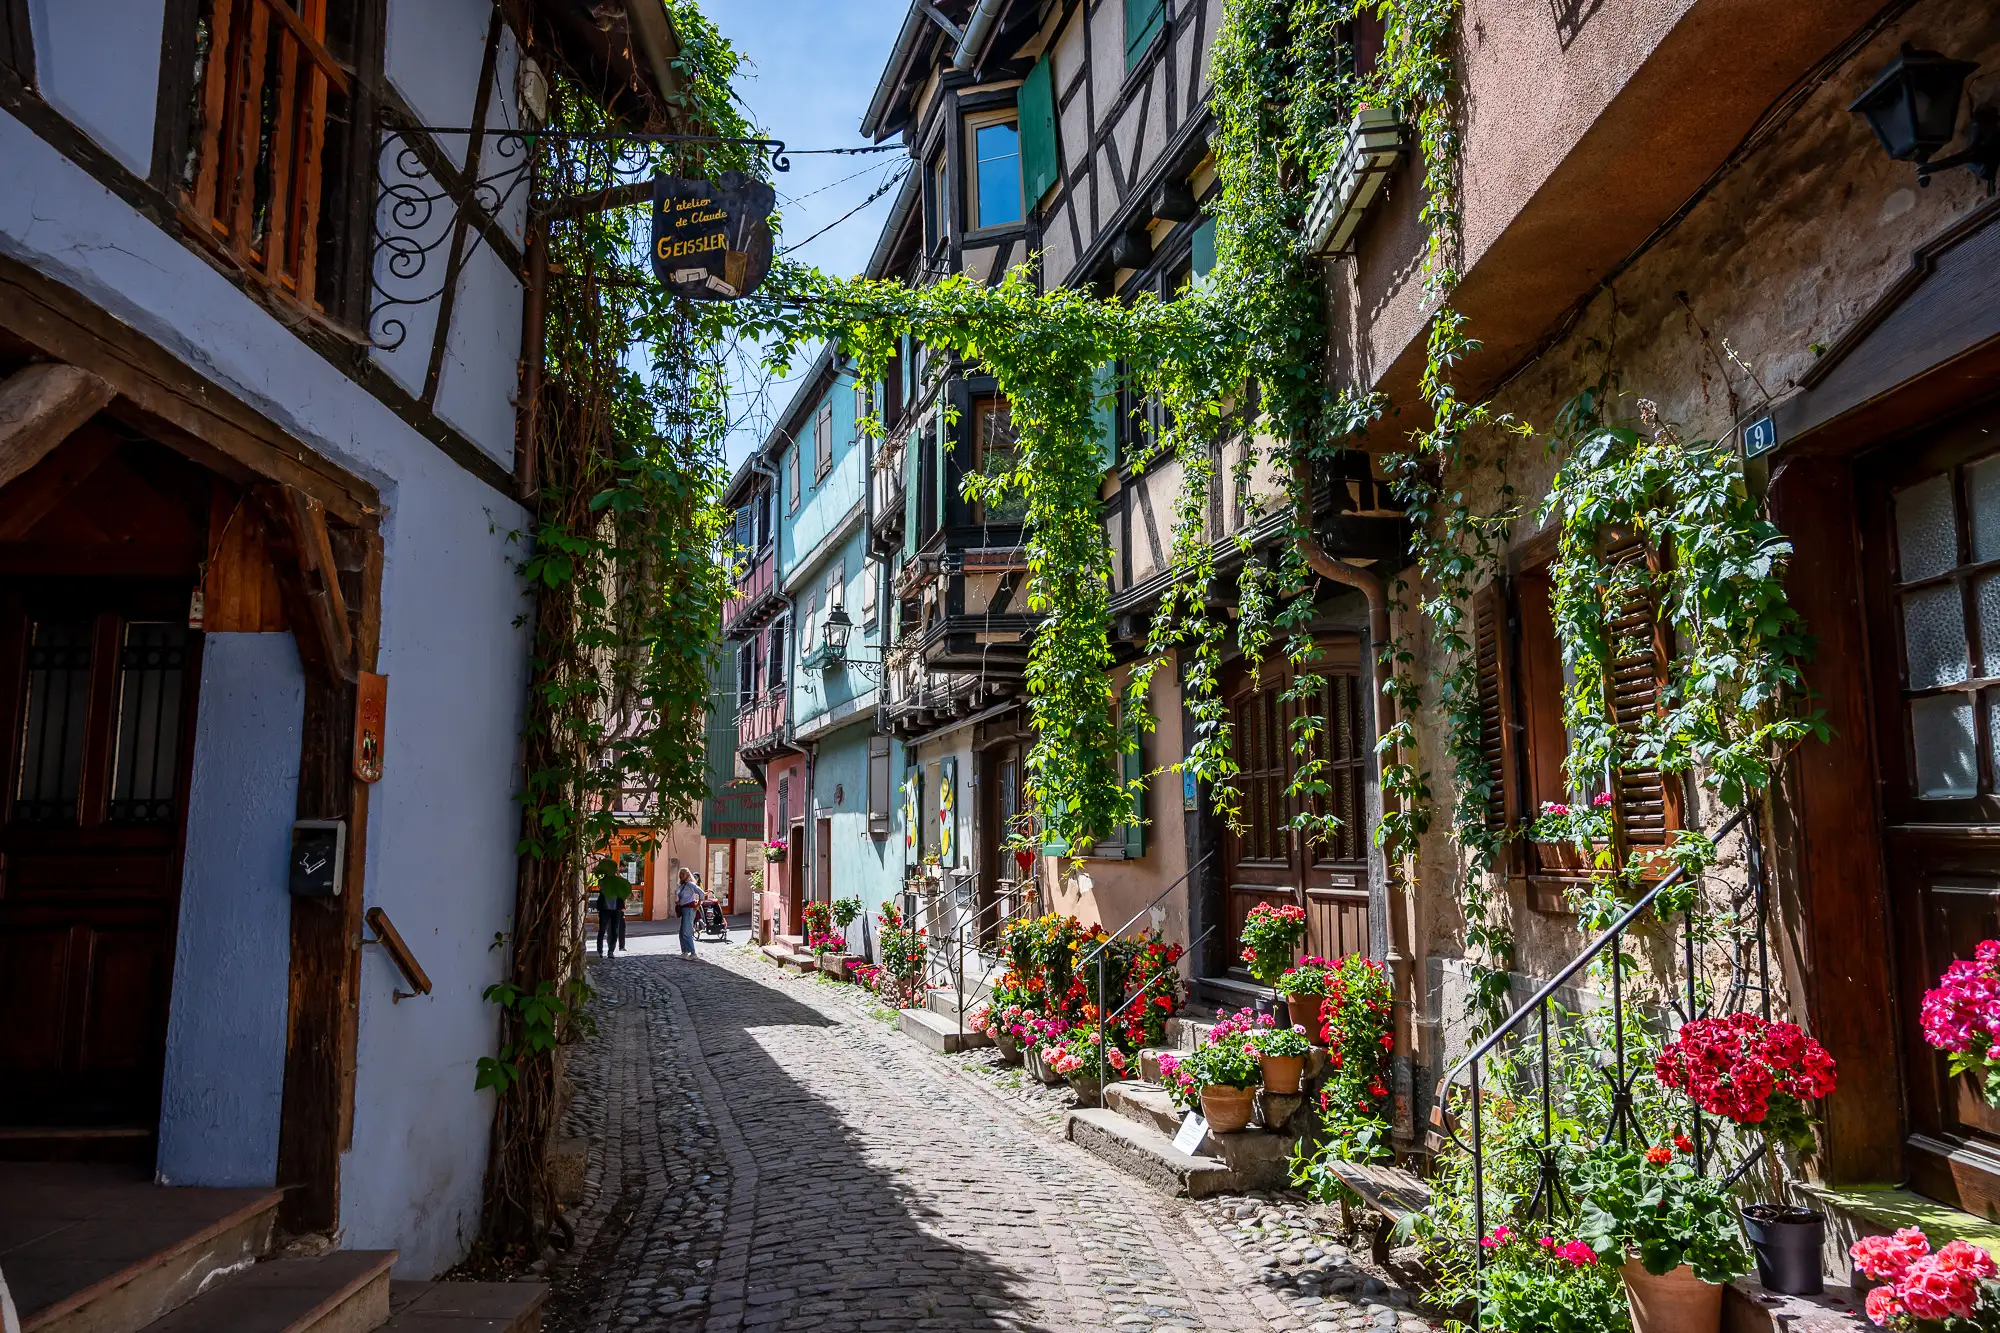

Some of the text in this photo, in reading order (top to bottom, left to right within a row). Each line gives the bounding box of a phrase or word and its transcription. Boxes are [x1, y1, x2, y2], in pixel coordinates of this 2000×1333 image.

[663, 197, 711, 213] l'atelier
[675, 208, 728, 228] de Claude
[1754, 425, 1764, 449] 9
